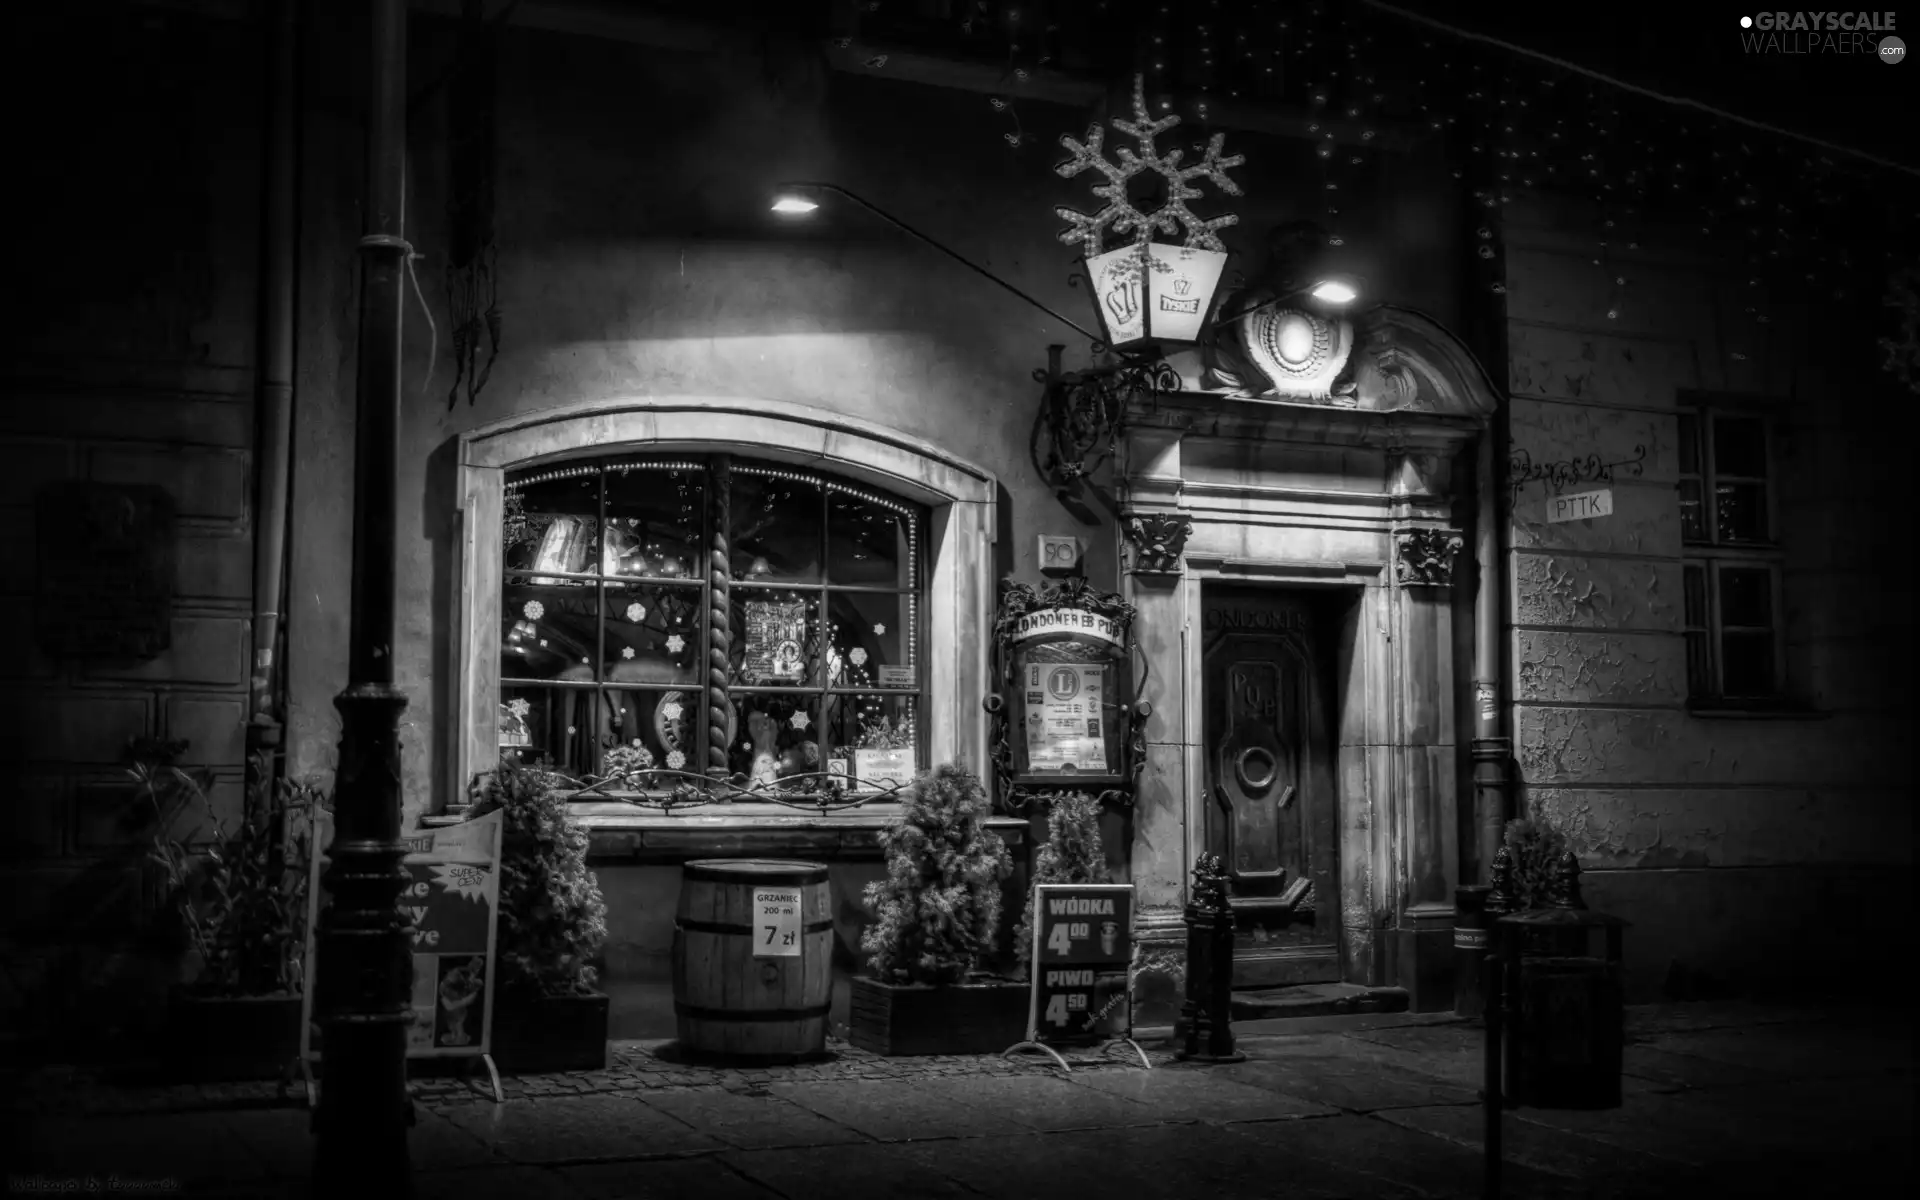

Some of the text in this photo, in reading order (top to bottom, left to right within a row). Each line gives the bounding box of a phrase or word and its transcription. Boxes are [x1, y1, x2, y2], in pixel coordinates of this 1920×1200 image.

[1556, 494, 1601, 518] PTTK
[1045, 543, 1073, 561] 90
[757, 894, 799, 903] GRZANIEC
[1049, 896, 1115, 916] WÓDKA
[764, 907, 780, 915] 200
[764, 925, 778, 946] 7
[1046, 970, 1095, 987] PIWO
